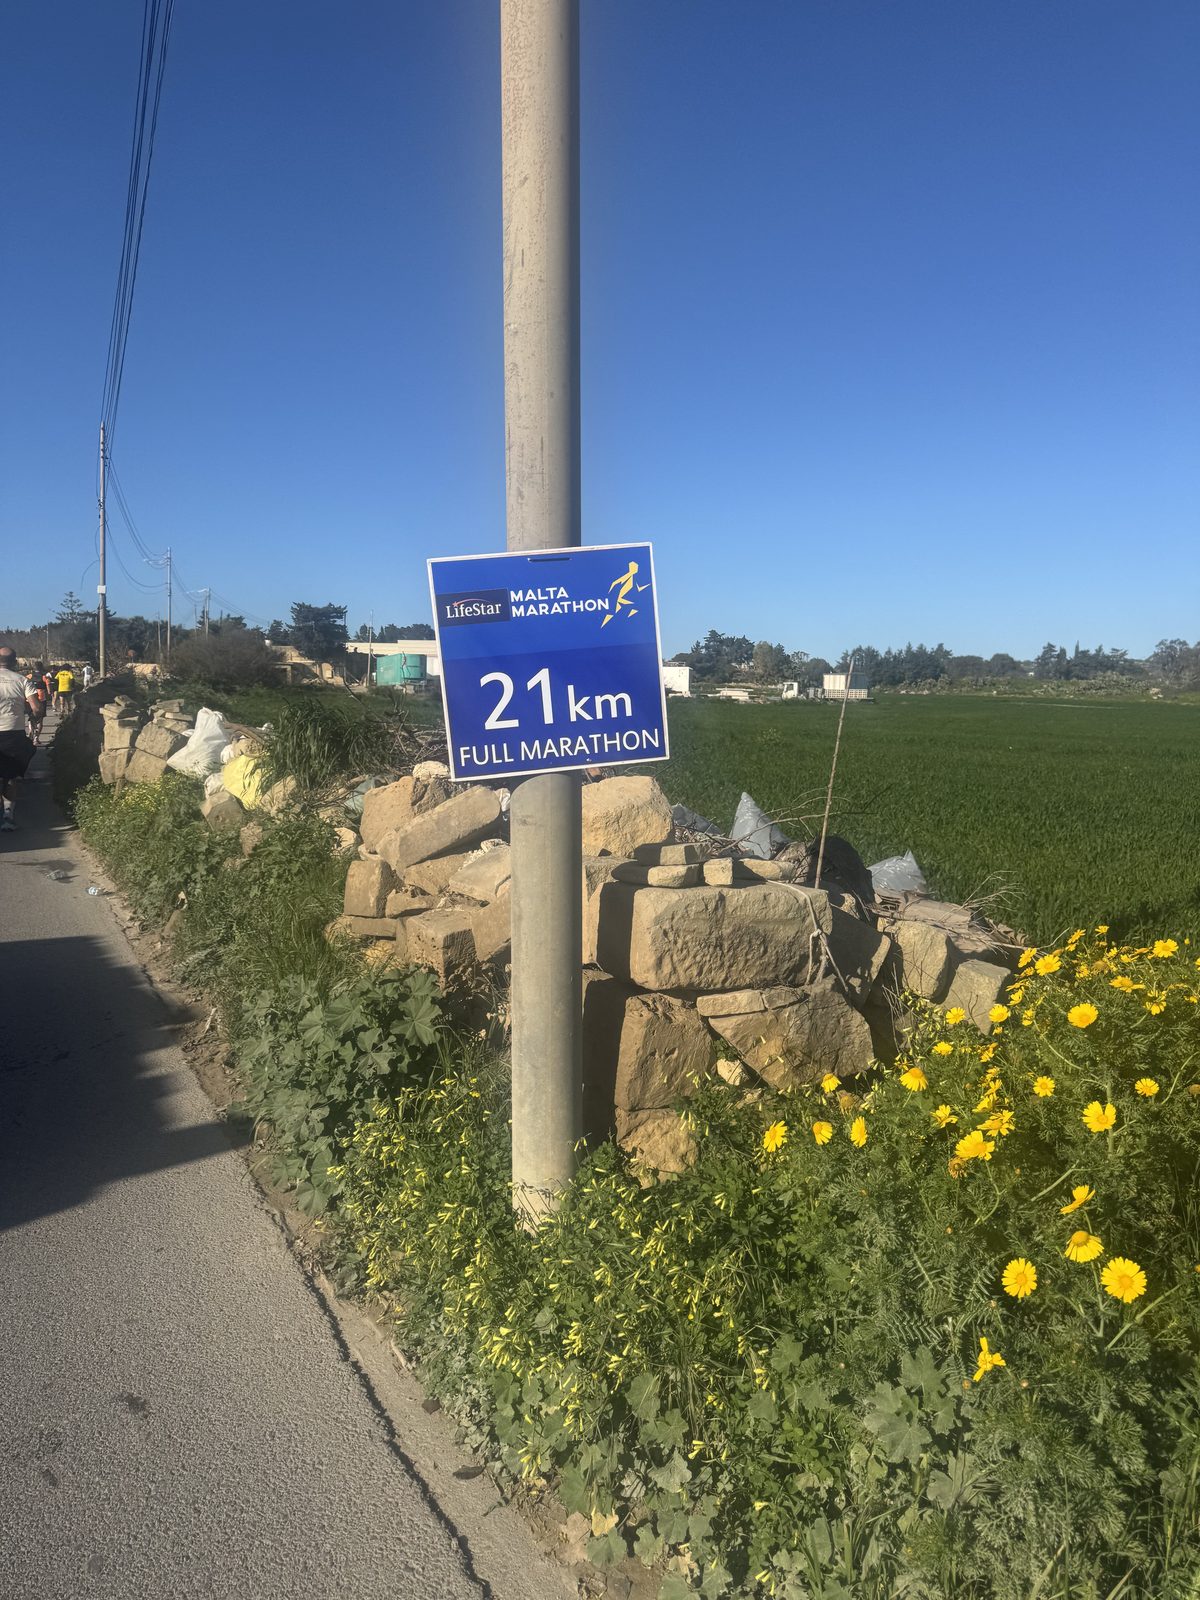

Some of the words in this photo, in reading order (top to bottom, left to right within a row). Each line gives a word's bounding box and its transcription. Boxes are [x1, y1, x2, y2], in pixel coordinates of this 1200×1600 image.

[510, 586, 569, 603] MALTA
[446, 602, 502, 619] LifeStar
[511, 598, 610, 618] MARATHON
[479, 667, 554, 731] 21
[567, 684, 633, 722] km
[459, 742, 514, 767] FULL
[520, 728, 660, 761] MARATHON
